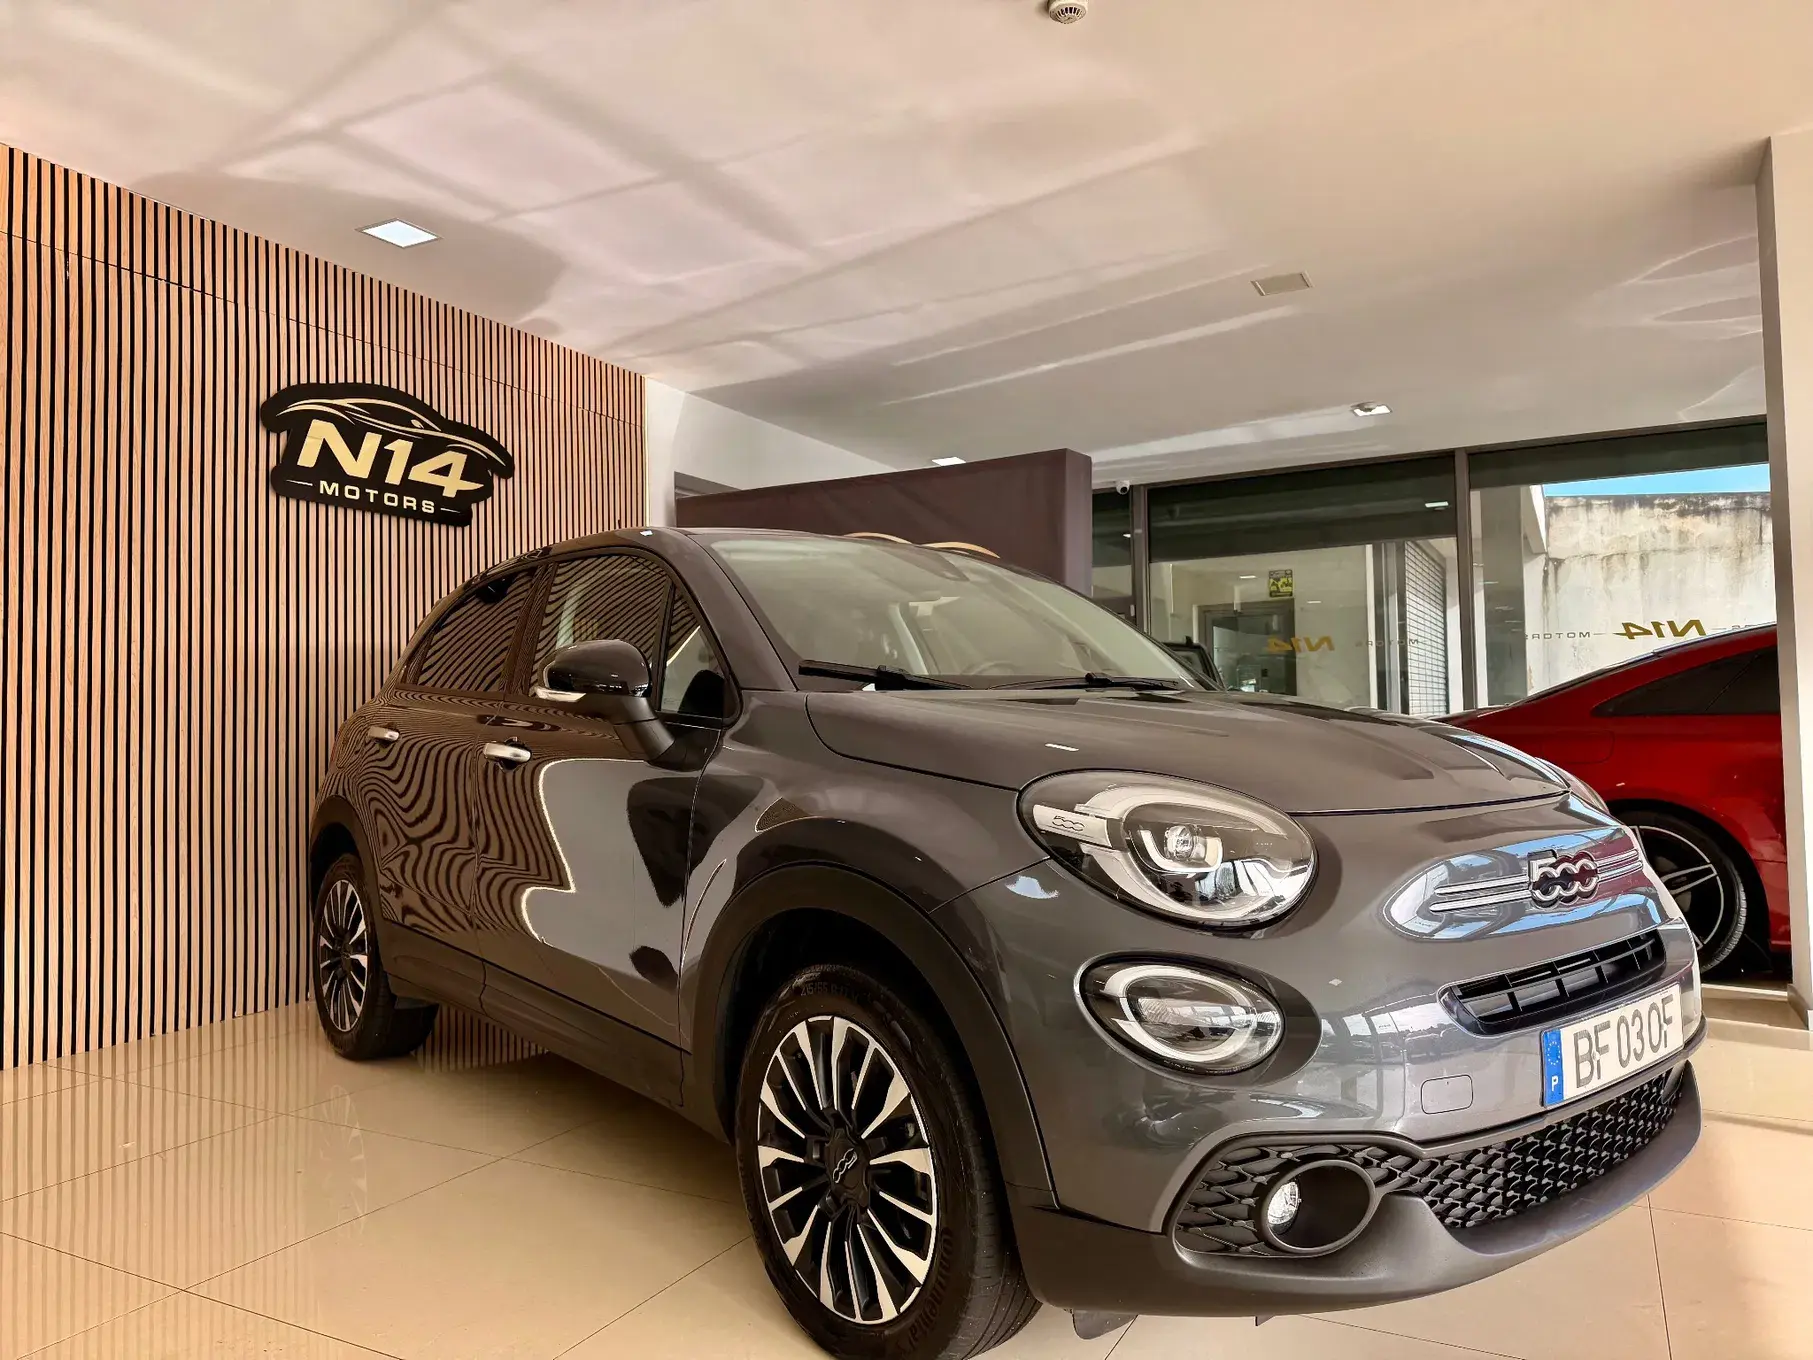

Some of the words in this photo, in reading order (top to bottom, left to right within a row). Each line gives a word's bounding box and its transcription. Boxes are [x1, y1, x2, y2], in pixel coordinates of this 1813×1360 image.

[297, 418, 484, 498] N14
[319, 480, 435, 514] MOTORS
[1052, 815, 1086, 832] 500
[1528, 850, 1599, 903] 500
[1573, 1020, 1611, 1088] BF
[1617, 1009, 1645, 1068] 03
[1551, 1075, 1559, 1091] P
